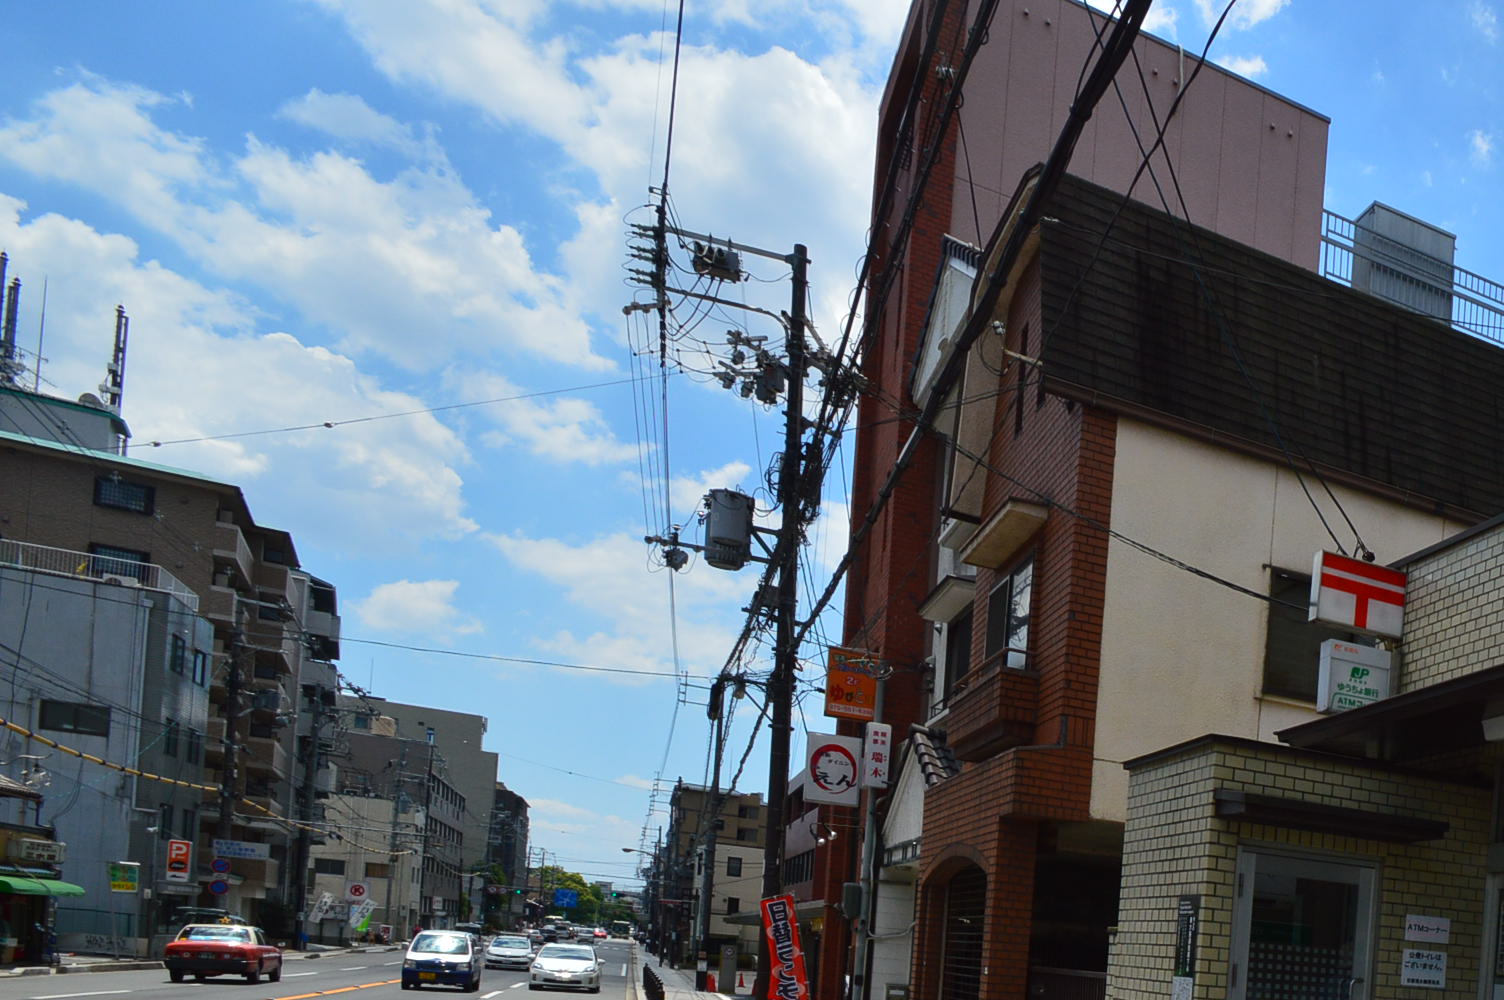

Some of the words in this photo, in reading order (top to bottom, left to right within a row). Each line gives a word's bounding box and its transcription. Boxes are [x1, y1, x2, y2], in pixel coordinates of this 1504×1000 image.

[1337, 682, 1379, 698] ゆうちょ銀行
[172, 843, 187, 859] P
[1407, 923, 1448, 934] ATMコーナー
